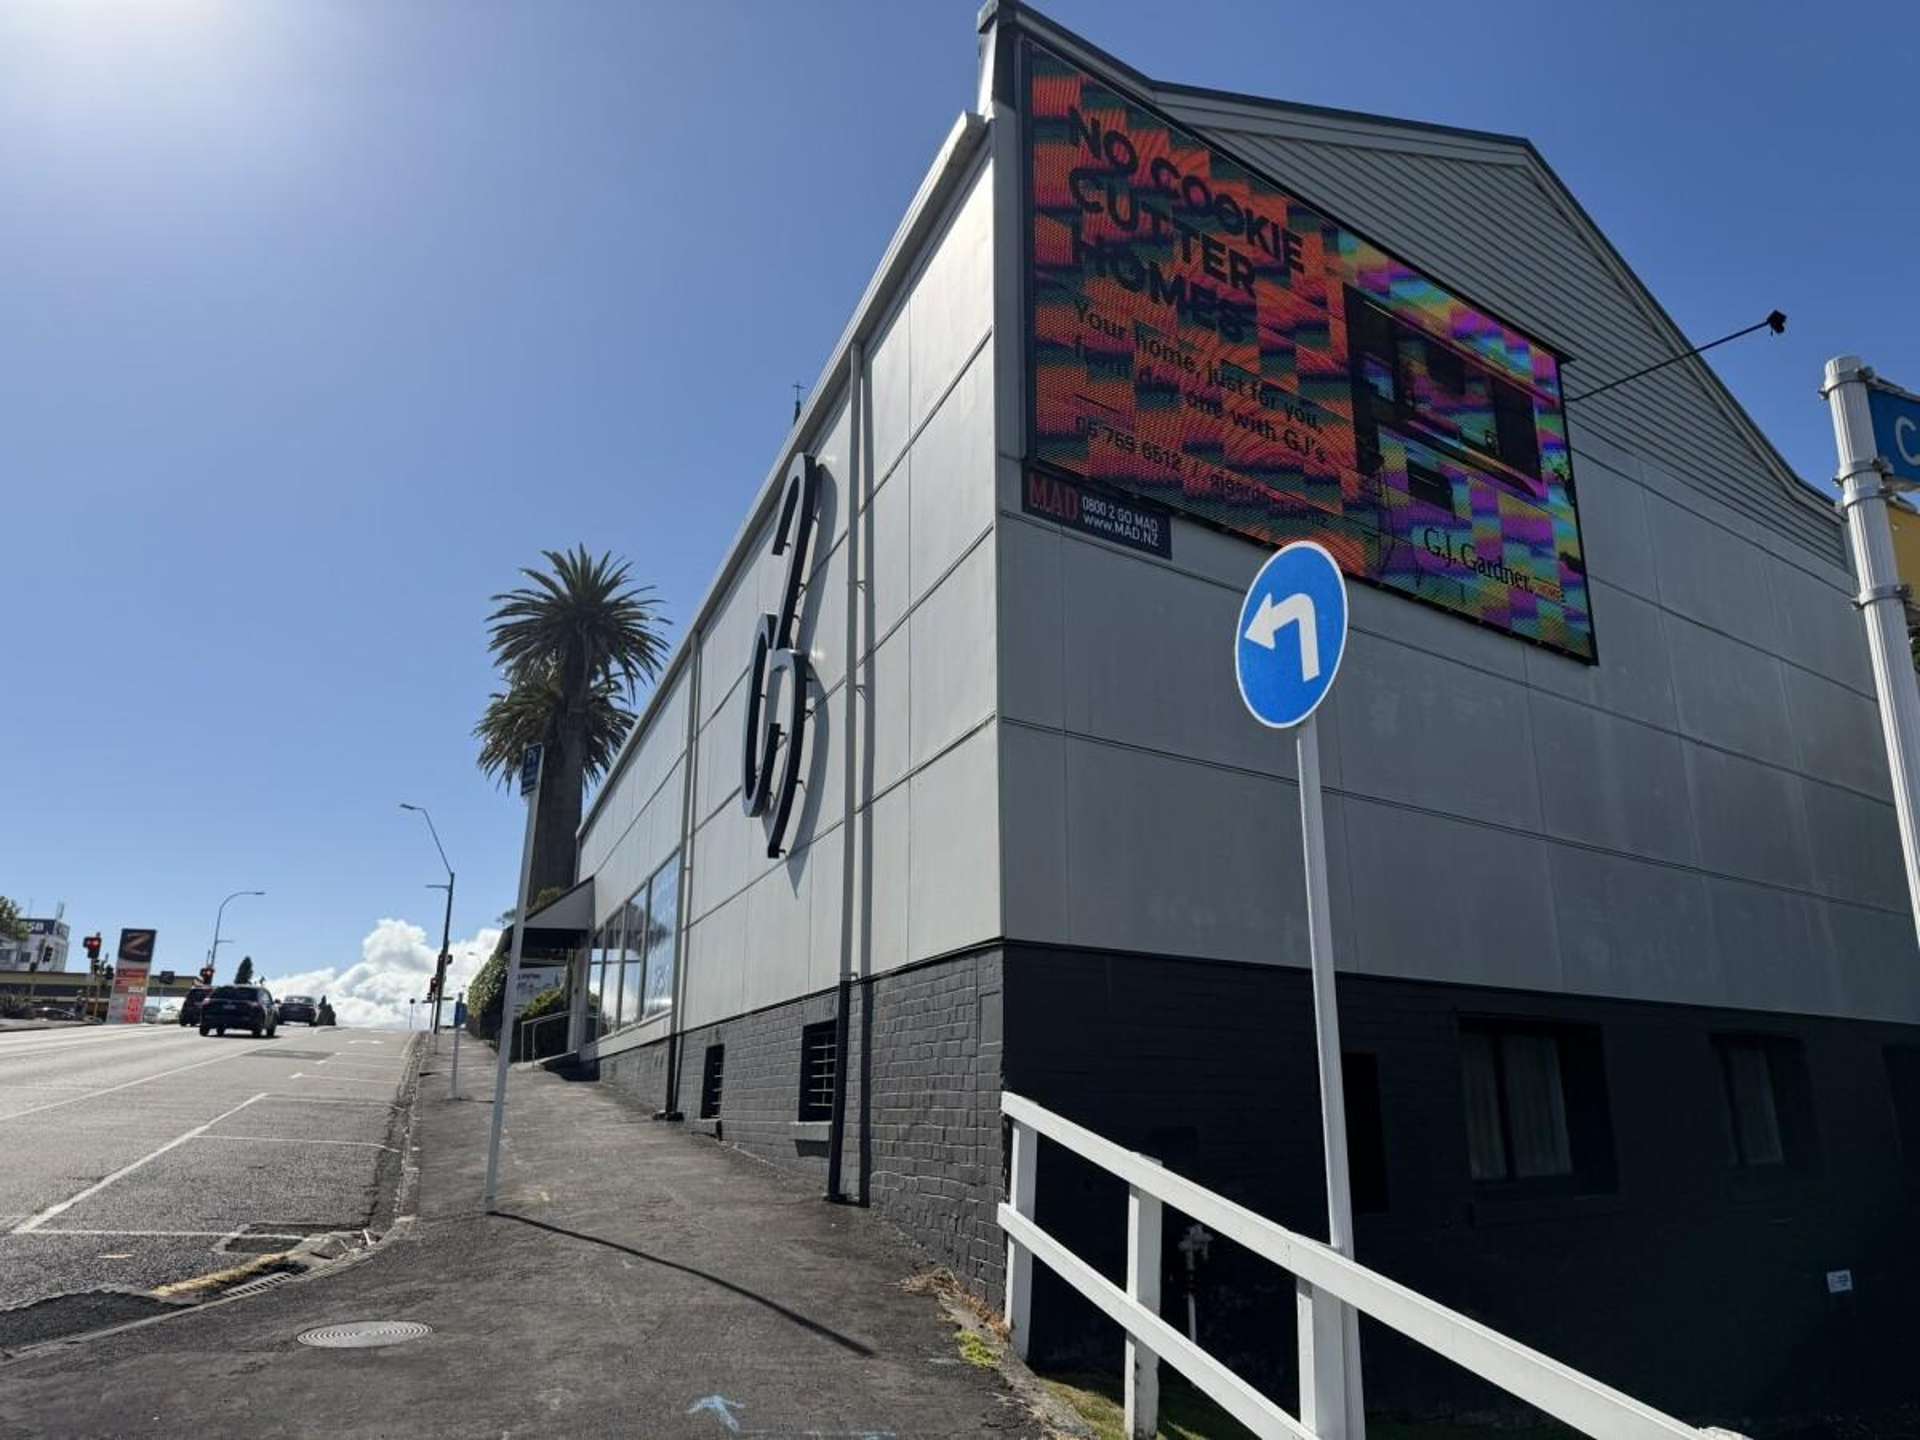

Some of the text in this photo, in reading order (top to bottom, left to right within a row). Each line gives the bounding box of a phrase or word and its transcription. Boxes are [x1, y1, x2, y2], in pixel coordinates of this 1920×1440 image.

[1069, 104, 1306, 273] NO COOKIE
[1074, 300, 1127, 340] Your
[1231, 410, 1277, 442] with
[1028, 471, 1158, 531] MAD 0800 2 GO MAD
